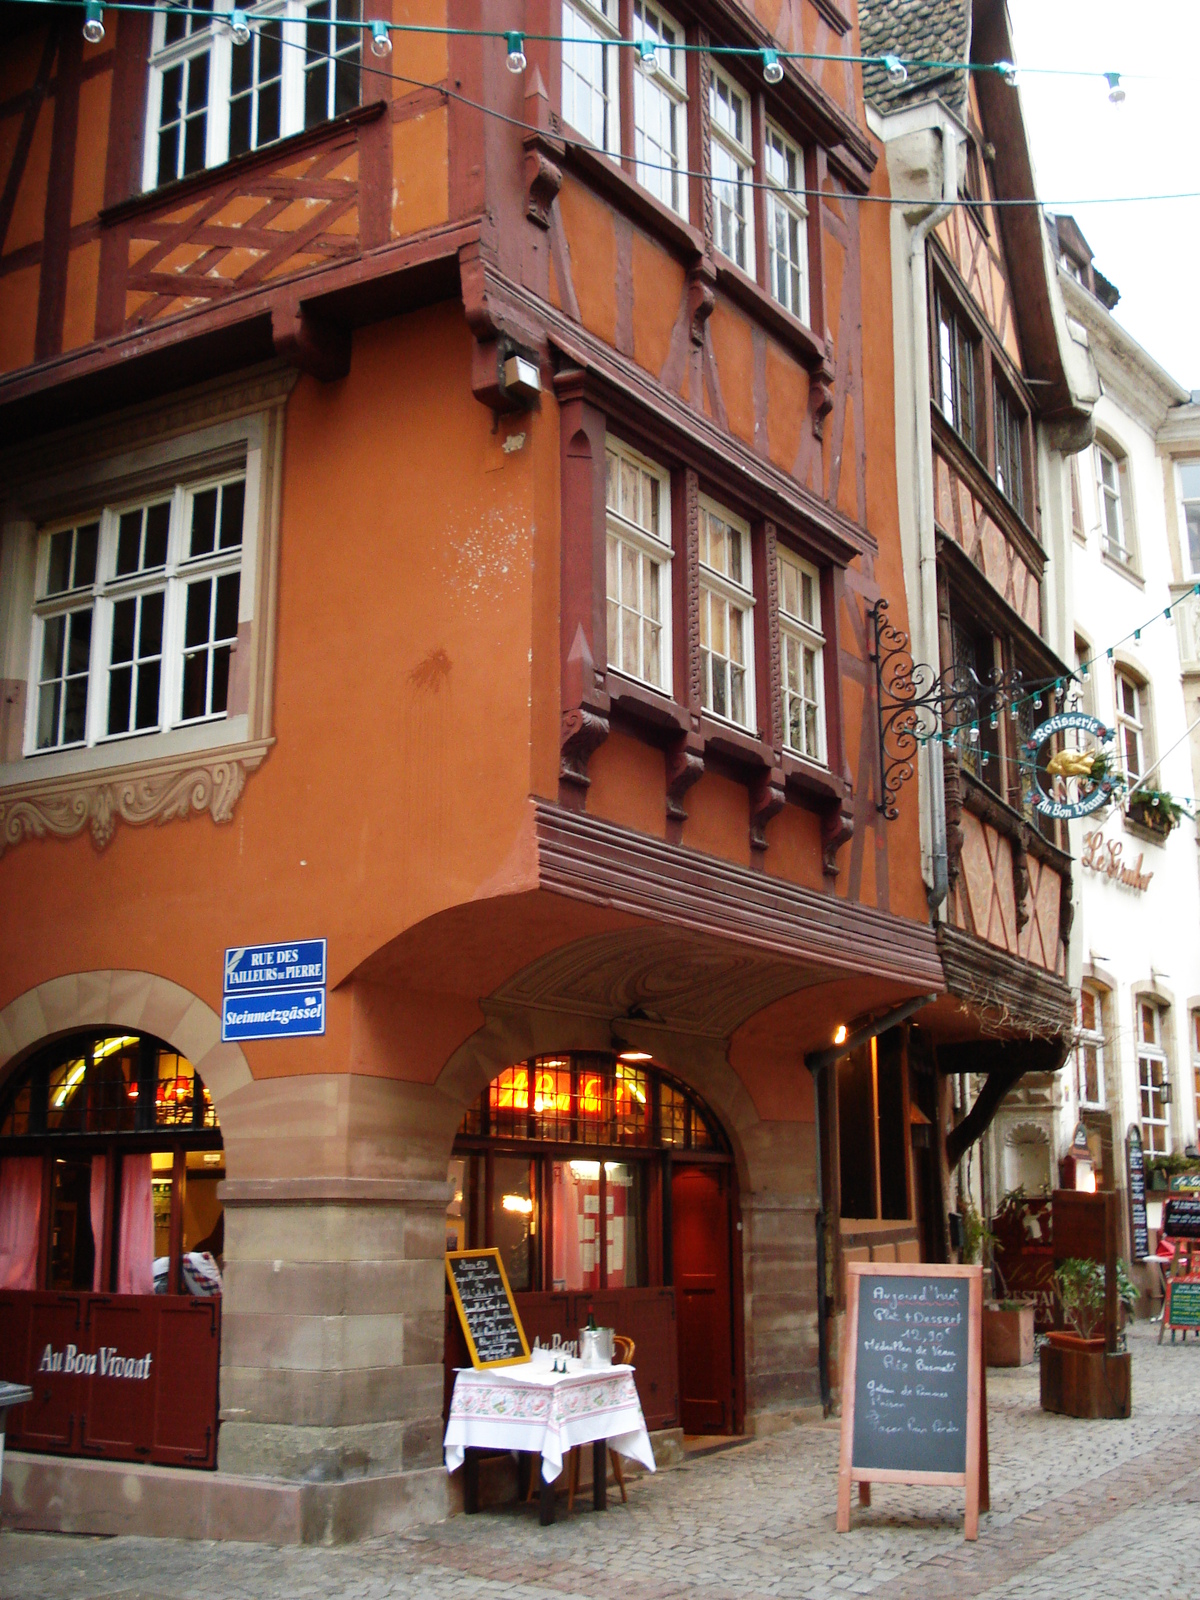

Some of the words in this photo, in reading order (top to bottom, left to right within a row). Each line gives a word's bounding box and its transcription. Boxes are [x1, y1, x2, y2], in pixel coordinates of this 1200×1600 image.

[1037, 797, 1052, 813] Au
[1052, 804, 1072, 818] Bon
[251, 951, 275, 967] RUE
[276, 949, 299, 964] DES
[229, 967, 278, 985] TAILLEURS
[285, 963, 322, 979] PIERRE
[225, 1003, 322, 1026] Steinmetzgässel
[873, 1285, 960, 1310] Aujourd'hui
[38, 1343, 63, 1372] Au
[63, 1343, 98, 1375] Bon
[99, 1346, 153, 1379] Vivant
